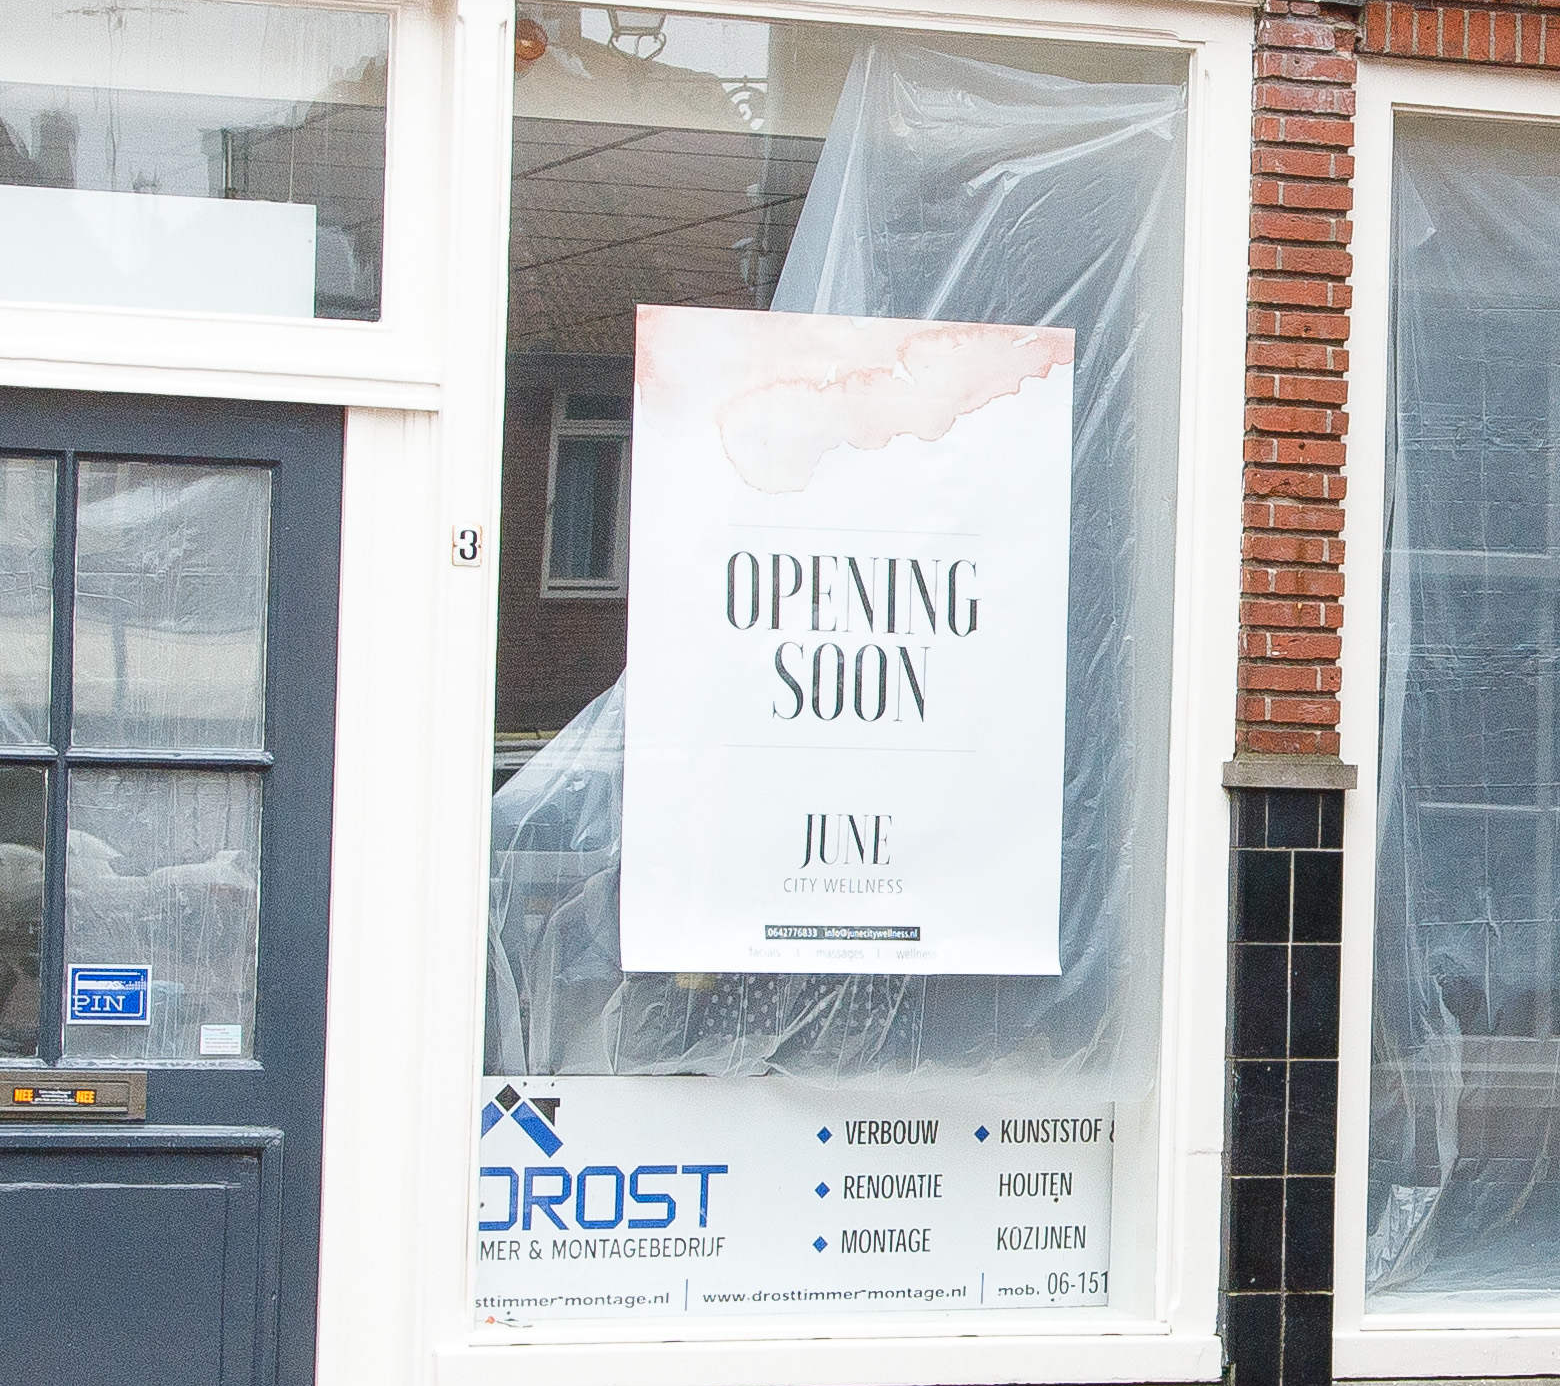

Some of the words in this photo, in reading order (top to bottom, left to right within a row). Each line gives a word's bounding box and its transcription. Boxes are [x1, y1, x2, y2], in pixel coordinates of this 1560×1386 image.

[459, 529, 477, 560] 3
[726, 551, 981, 637] OPENING
[772, 641, 931, 722] SOON
[798, 813, 892, 869] JUNE
[783, 878, 817, 893] CITY
[824, 878, 903, 894] WELLNESS
[767, 927, 818, 938] 0642776833
[824, 927, 918, 940] info@junecitywellness.nl
[816, 948, 865, 961] massages
[896, 948, 938, 960] wellness
[72, 995, 126, 1011] PIN
[14, 1088, 34, 1102] NEE
[76, 1090, 95, 1103] NEE
[846, 1120, 939, 1144] VERBOUW
[1001, 1119, 1102, 1143] KUNSTSTOF
[844, 1174, 943, 1199] RENOVATIE
[999, 1172, 1073, 1197] HOUTEN
[478, 1164, 728, 1231] DROST
[528, 1239, 543, 1260] &
[552, 1237, 726, 1260] MONTAGEBEDRIJF
[841, 1228, 931, 1254] MONTAGE
[997, 1226, 1086, 1250] KOZIJNEN
[998, 1285, 1040, 1296] mob.
